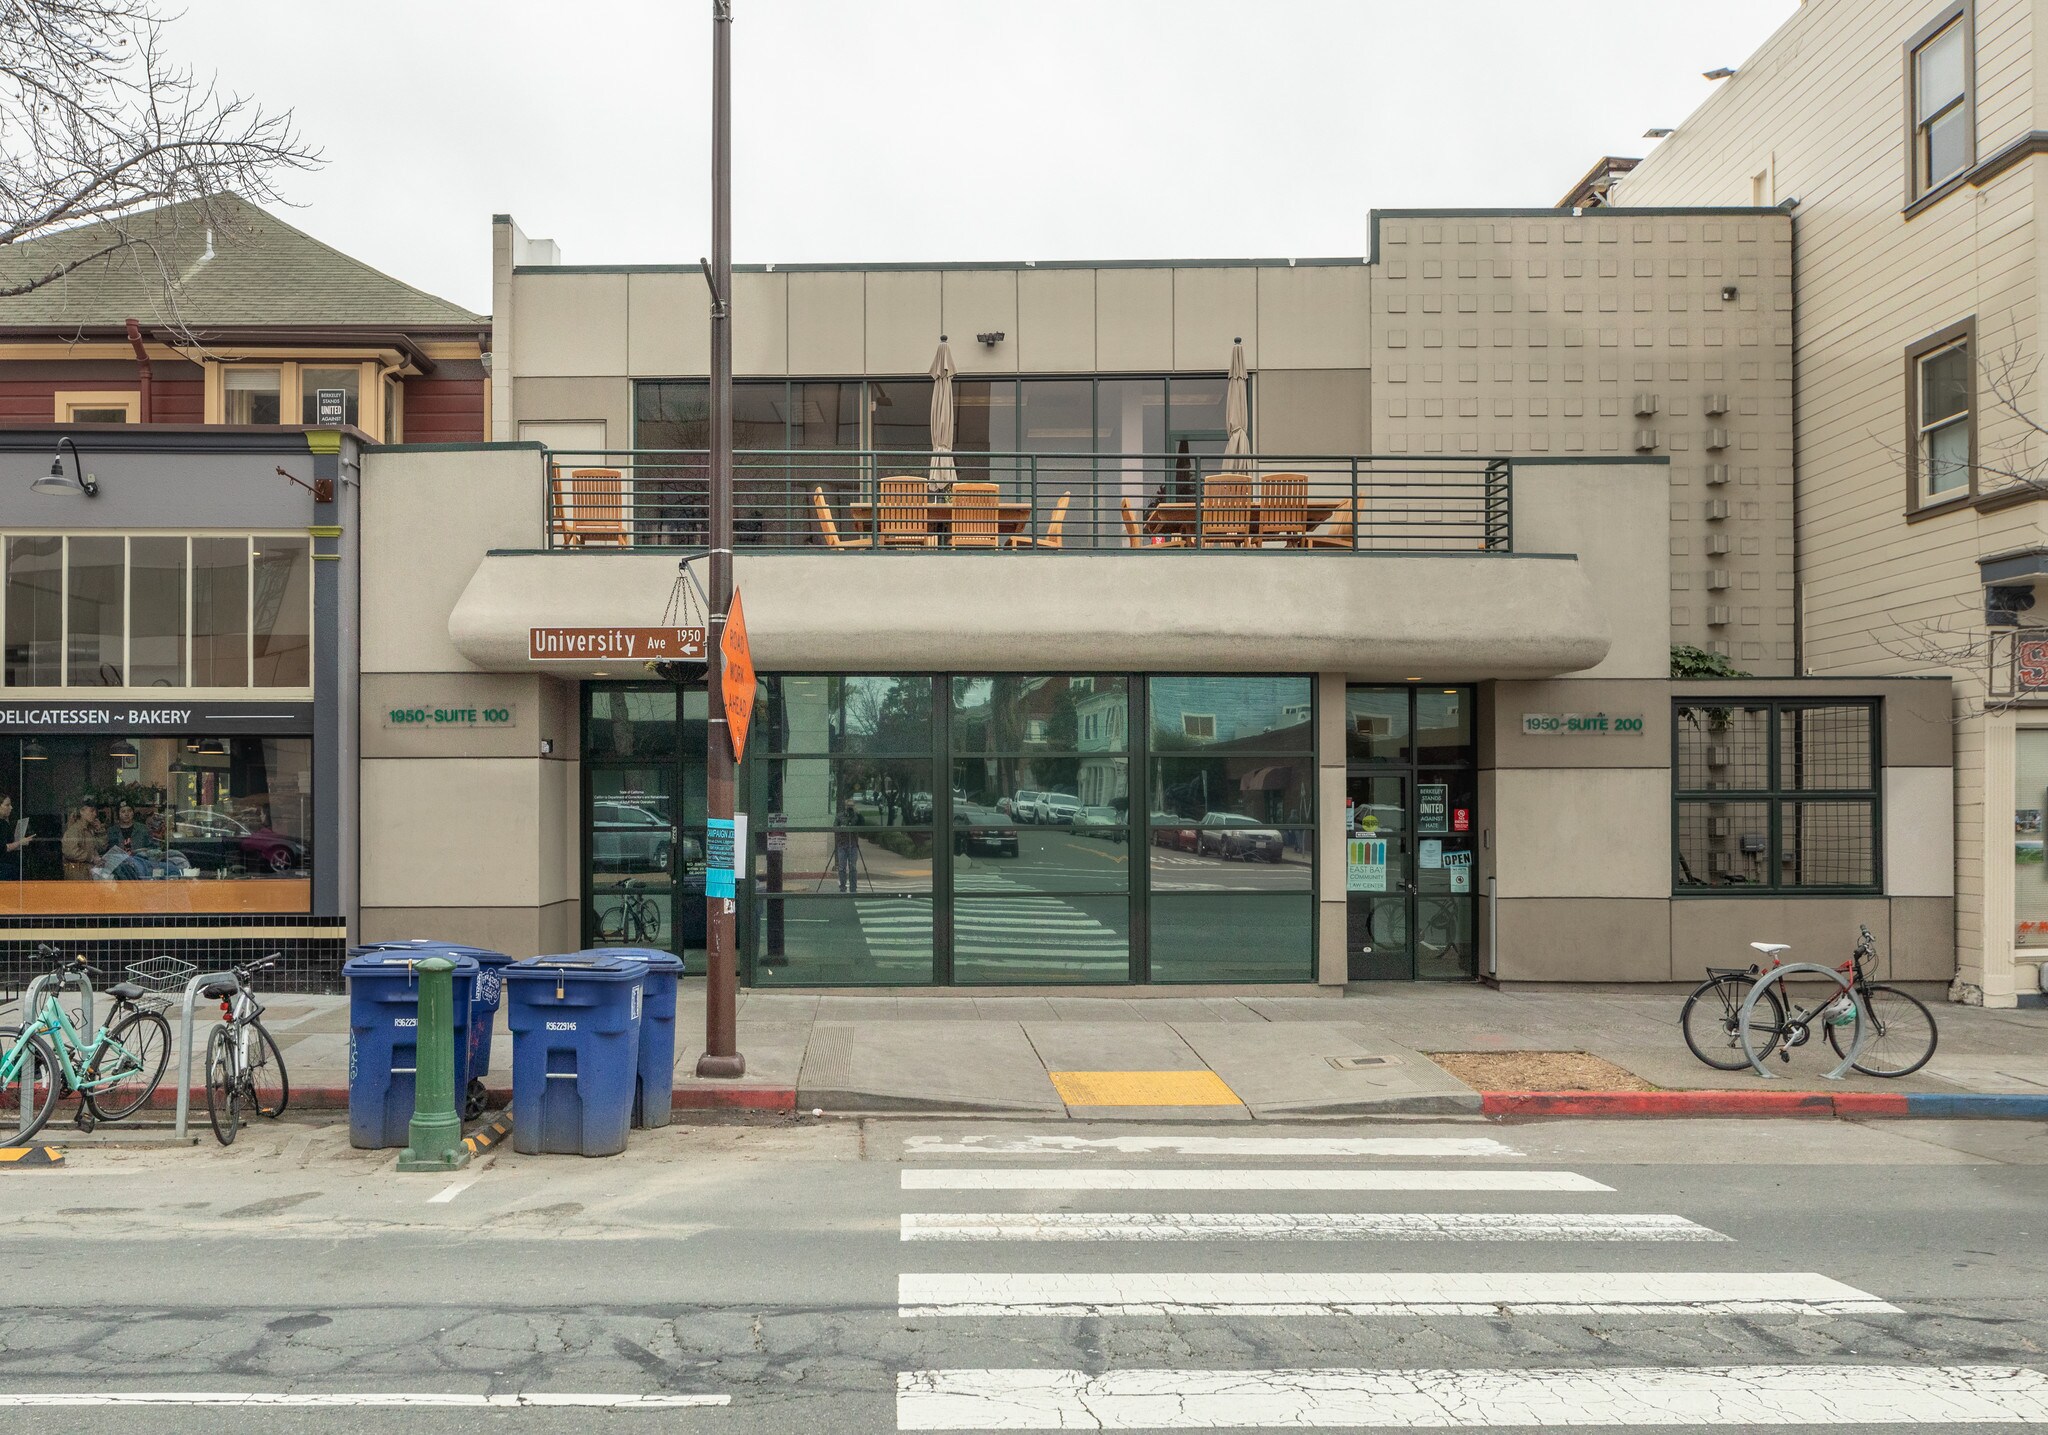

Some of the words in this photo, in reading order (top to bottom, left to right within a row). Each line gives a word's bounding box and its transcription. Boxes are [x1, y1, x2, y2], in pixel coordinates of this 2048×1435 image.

[321, 405, 342, 415] UNITED
[677, 629, 701, 642] 1950
[729, 628, 745, 655] ROAD
[535, 630, 635, 657] University
[647, 637, 666, 650] Ave
[728, 693, 747, 718] AHEAD
[128, 710, 191, 724] BAKERY
[389, 709, 477, 722] 1950-SUITE
[482, 709, 509, 722] 100
[1525, 718, 1608, 731] 1950-SUITE
[1614, 718, 1643, 731] 200
[1420, 804, 1443, 814] UNITED
[1444, 853, 1471, 866] OPEN
[546, 1021, 577, 1031] R96229145
